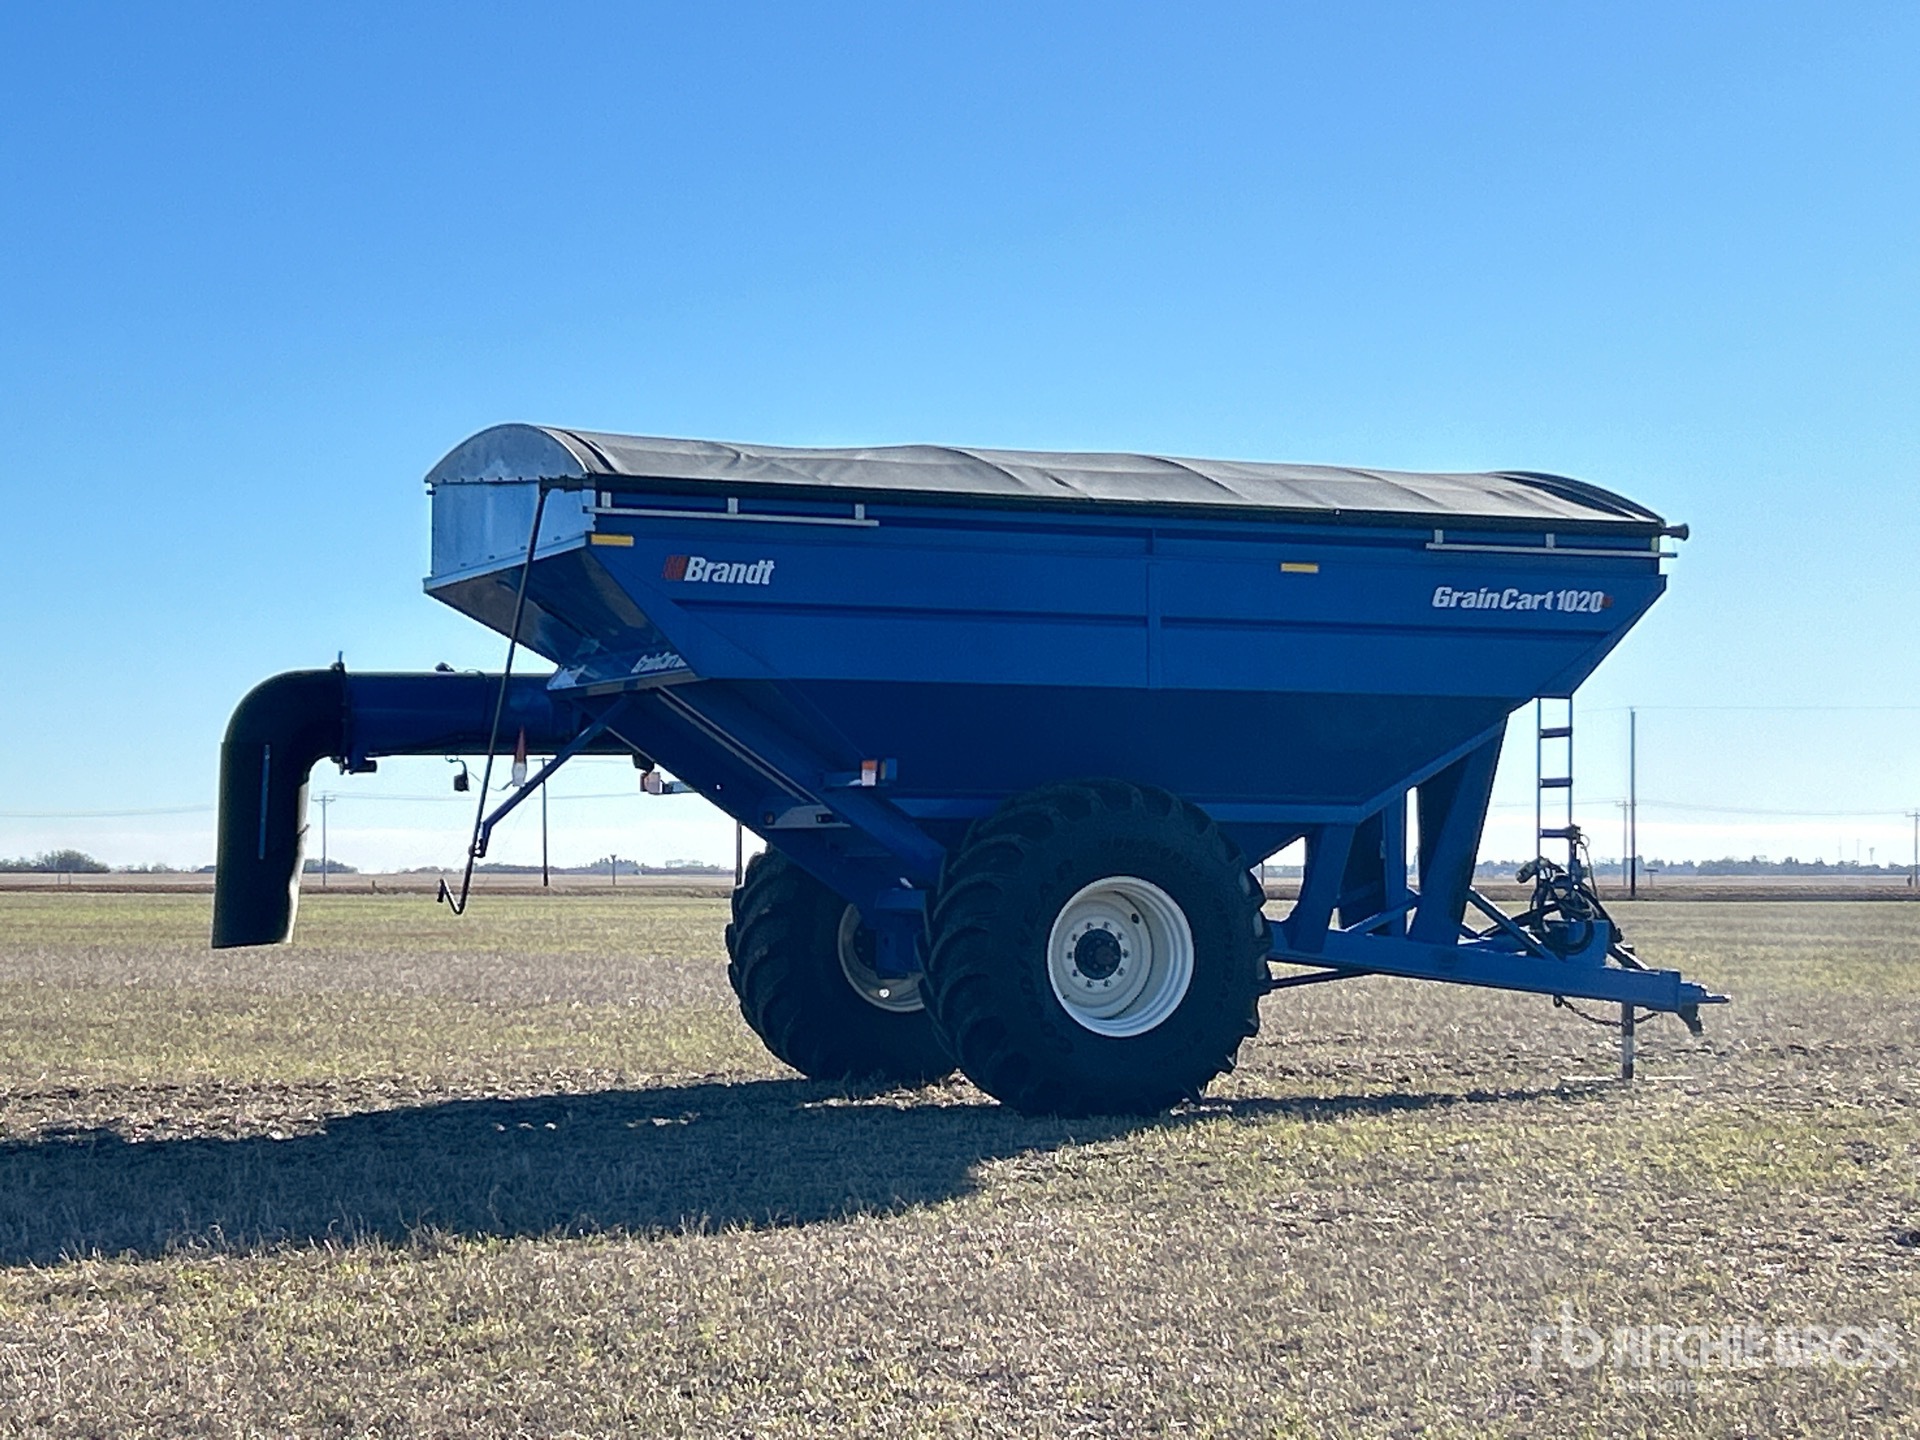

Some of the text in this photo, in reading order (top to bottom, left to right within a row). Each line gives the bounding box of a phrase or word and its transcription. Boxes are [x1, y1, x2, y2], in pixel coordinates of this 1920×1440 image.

[684, 556, 775, 585] Brandt
[1432, 586, 1604, 613] GrainCart 1020
